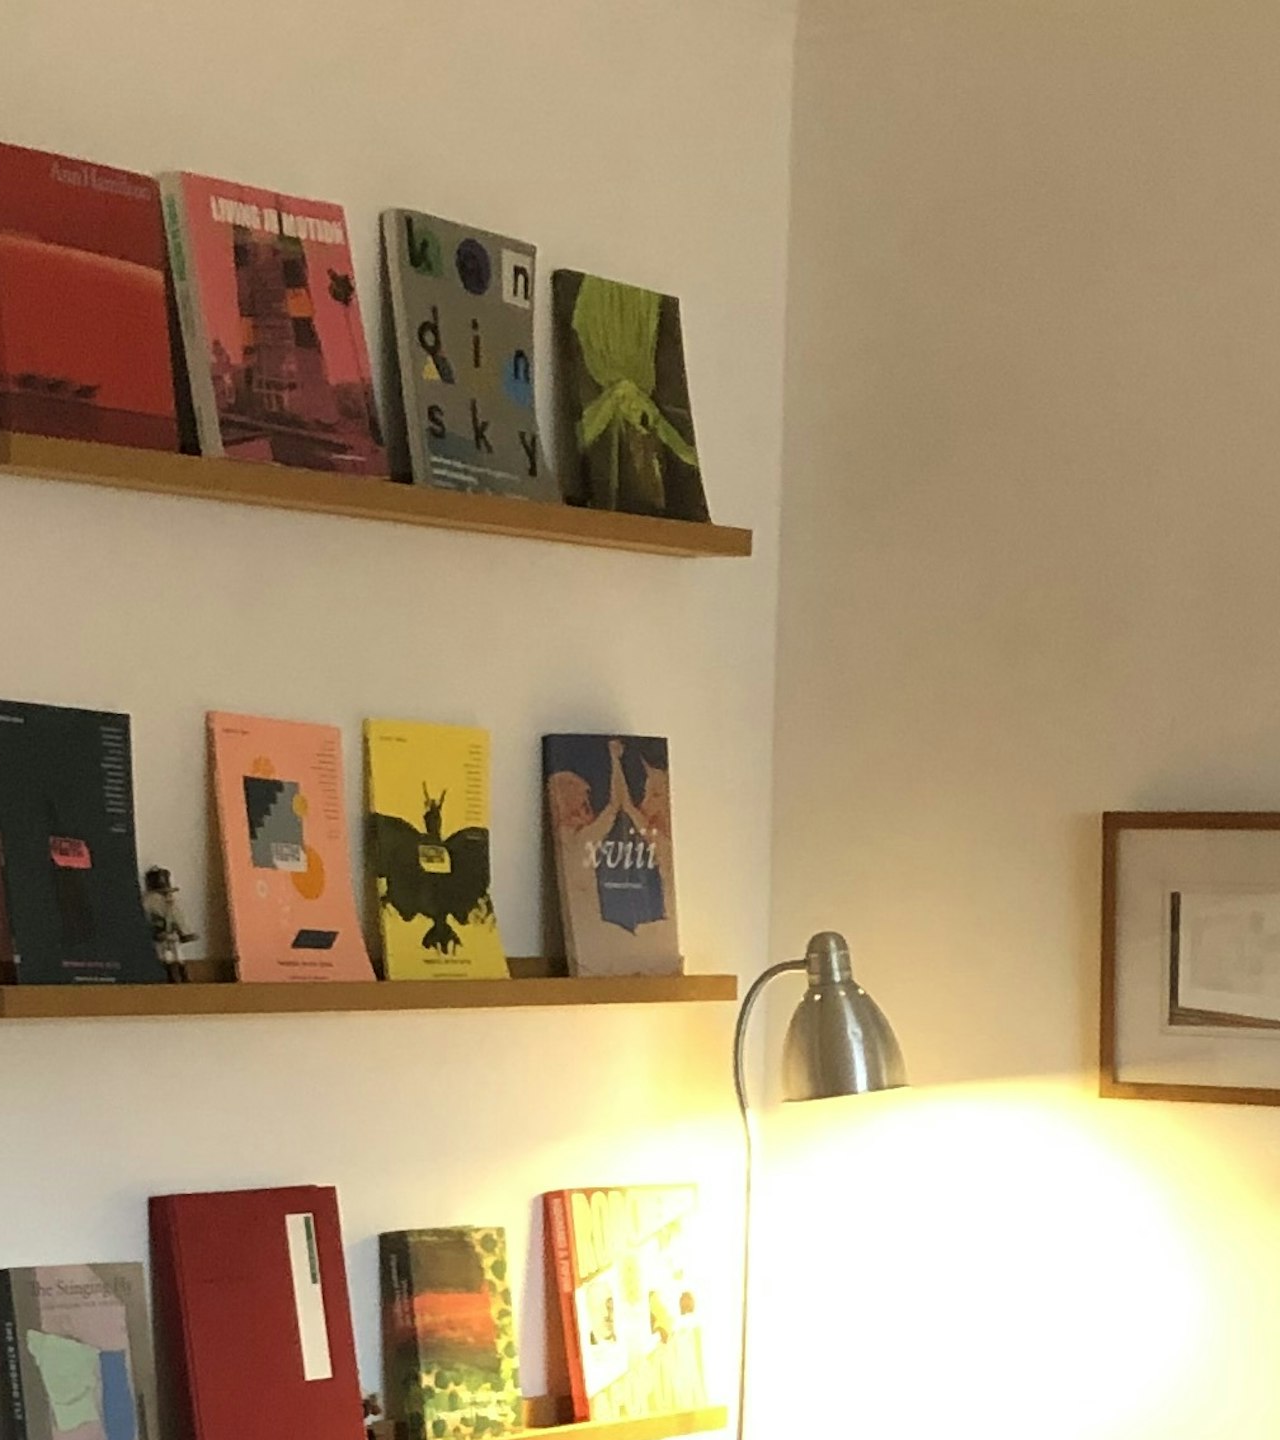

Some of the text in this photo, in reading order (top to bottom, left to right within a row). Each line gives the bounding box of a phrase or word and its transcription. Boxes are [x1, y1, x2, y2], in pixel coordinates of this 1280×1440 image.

[210, 194, 262, 231] LIVING
[281, 212, 346, 246] MOTION
[582, 827, 658, 870] xviii
